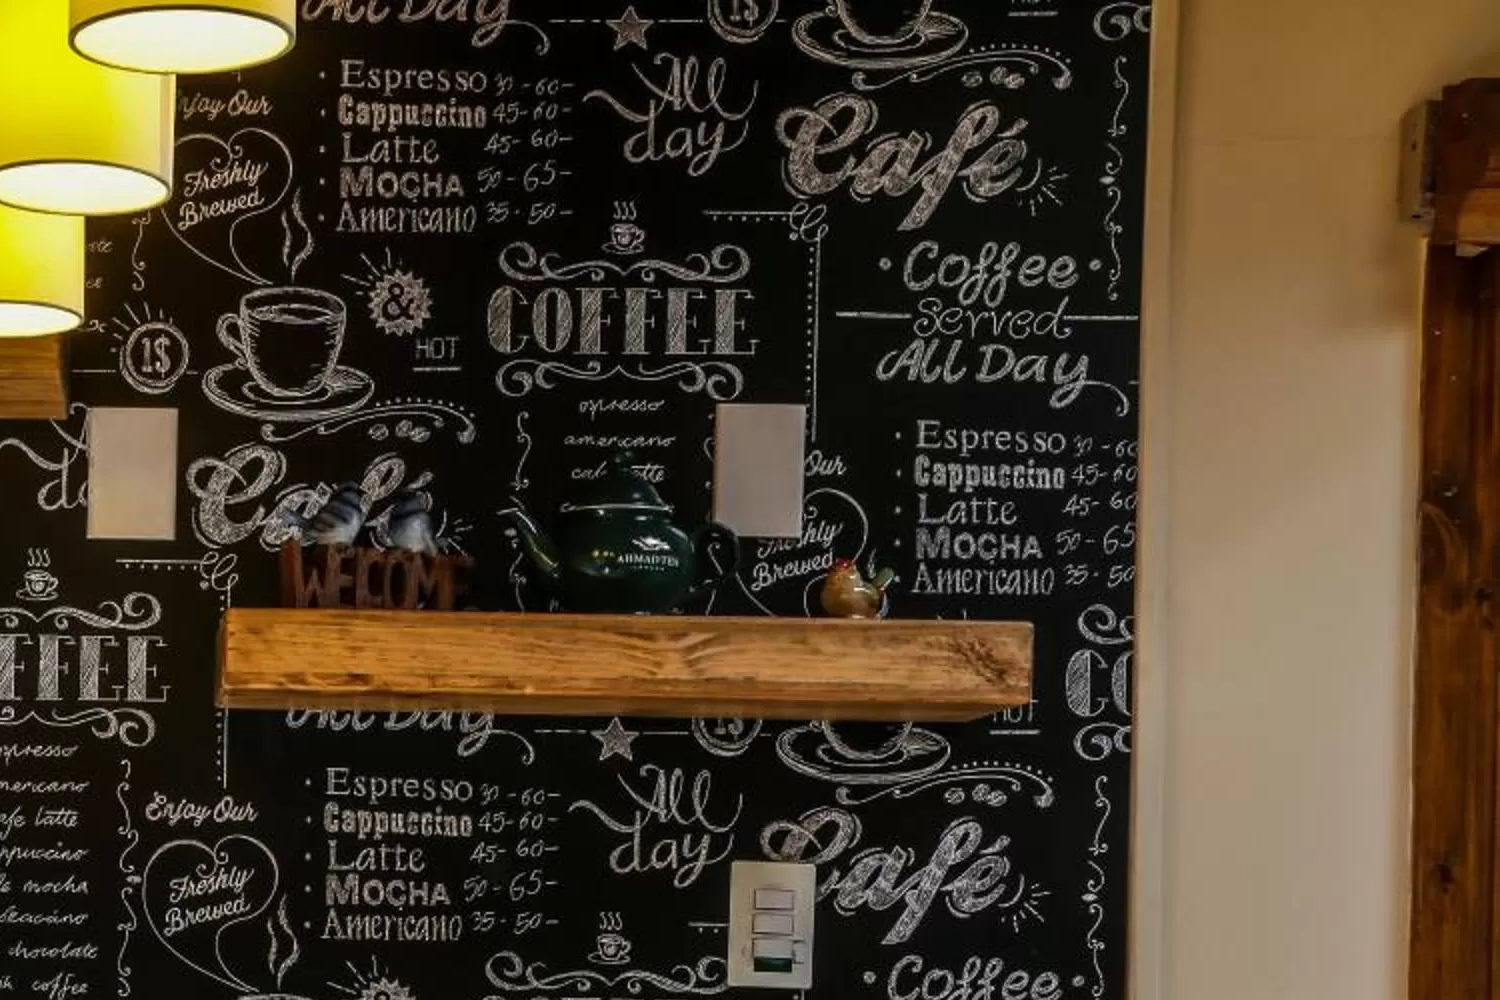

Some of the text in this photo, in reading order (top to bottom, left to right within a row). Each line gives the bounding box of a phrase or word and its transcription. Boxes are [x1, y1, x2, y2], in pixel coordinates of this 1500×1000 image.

[340, 59, 487, 98] Espresso
[338, 95, 487, 131] Cappuccino
[340, 133, 440, 165] Latte
[623, 104, 749, 176] day
[183, 159, 269, 200] Freshly
[775, 92, 1028, 231] Café
[340, 165, 464, 198] MOCHA
[177, 189, 265, 232] Brewed
[335, 201, 478, 234] Americano
[902, 240, 1080, 307] Coffee
[486, 285, 759, 356] COFFEE
[913, 297, 1073, 341] Served
[415, 337, 457, 360] HOT
[916, 419, 1067, 455] Espresso
[917, 493, 1018, 526] Latte
[915, 529, 1044, 564] MOCHA
[325, 768, 473, 804] Espresso
[144, 790, 258, 829] Enjoy Our
[323, 802, 473, 838] Cappuccino
